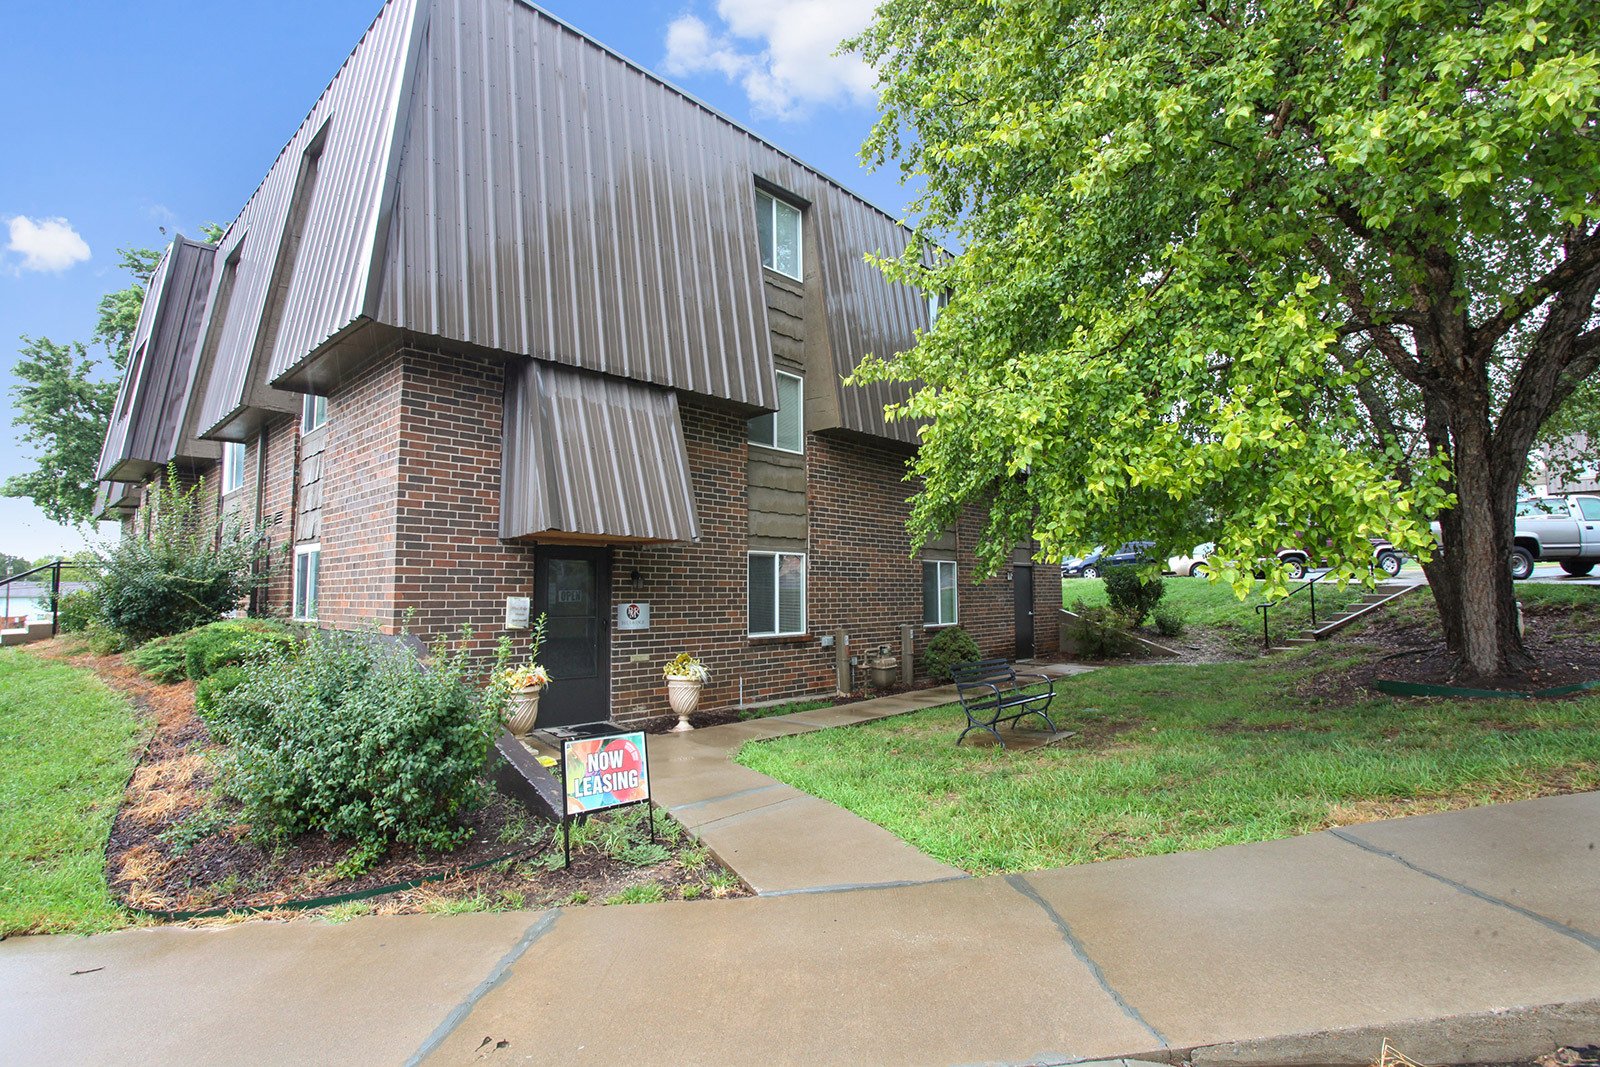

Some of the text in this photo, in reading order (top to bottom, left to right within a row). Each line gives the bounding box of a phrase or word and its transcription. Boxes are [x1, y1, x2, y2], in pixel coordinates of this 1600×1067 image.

[560, 590, 581, 601] OPEN
[587, 749, 624, 773] NOW
[574, 769, 639, 798] LEASING
